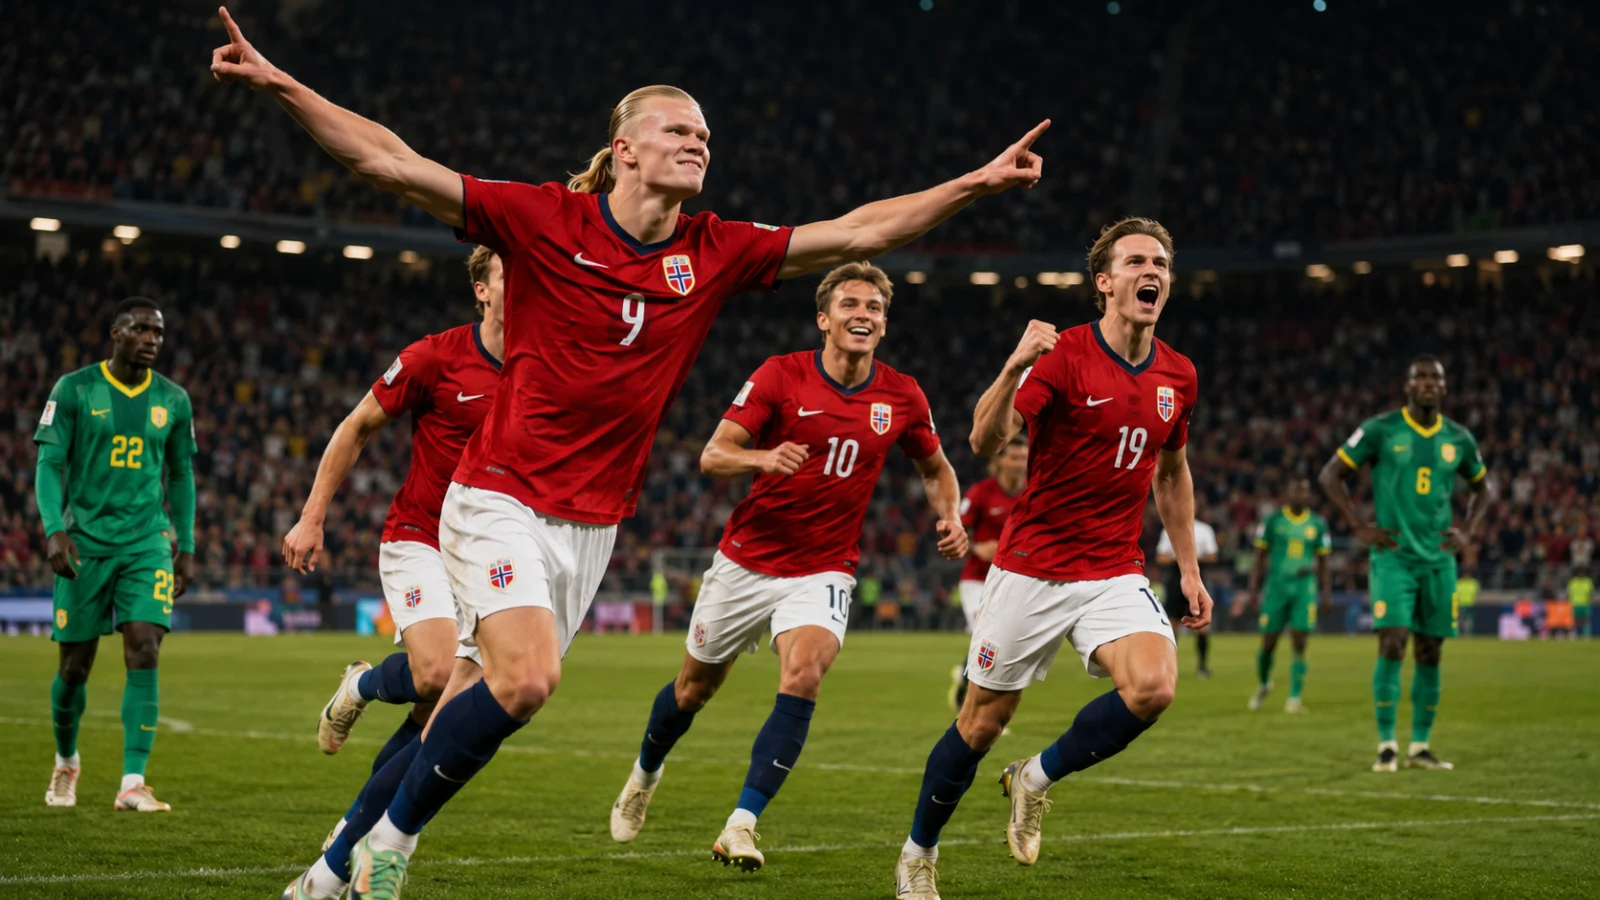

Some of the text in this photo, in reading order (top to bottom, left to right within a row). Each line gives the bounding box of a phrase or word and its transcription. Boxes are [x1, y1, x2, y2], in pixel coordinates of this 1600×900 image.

[620, 293, 646, 347] 9
[109, 435, 144, 468] 22
[824, 437, 860, 479] 10
[1113, 426, 1148, 470] 19
[1415, 467, 1432, 495] 6
[826, 584, 848, 619] 10
[1138, 588, 1160, 613] 1
